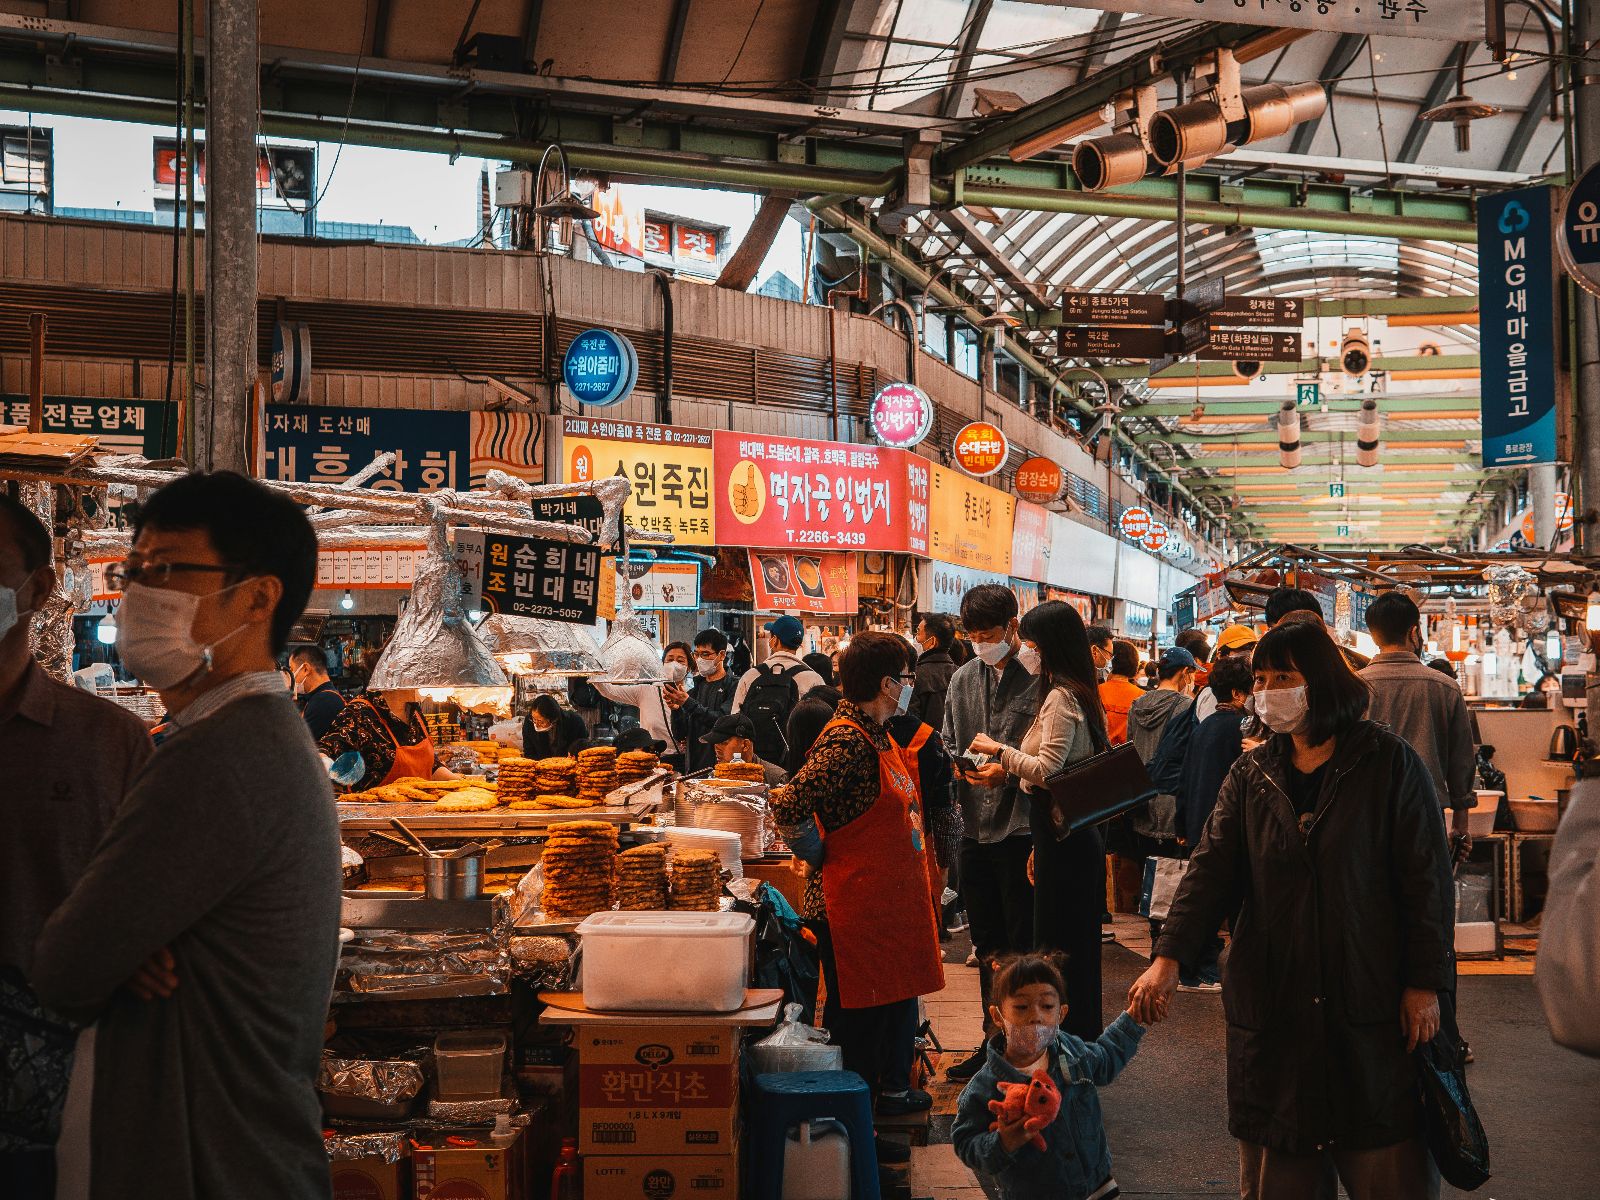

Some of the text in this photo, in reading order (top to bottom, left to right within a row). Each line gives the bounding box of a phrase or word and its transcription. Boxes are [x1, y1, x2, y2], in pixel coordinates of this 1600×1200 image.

[1249, 299, 1275, 310] 청계천
[568, 355, 619, 376] 수원아줌마
[575, 382, 610, 391] 2271-2627
[43, 404, 144, 430] 전문업체
[318, 416, 371, 435] 도산매
[565, 420, 589, 435] 2대째
[591, 423, 633, 439] 수원아줌마
[645, 427, 661, 441] 전문
[964, 456, 996, 467] 빈대떡
[1019, 471, 1059, 488] 광장순대
[540, 502, 577, 516] 박가네
[679, 517, 709, 535] 녹두죽
[786, 530, 866, 545] T.2266-3439
[514, 544, 597, 578] 순희네
[513, 572, 594, 606] 빈대떡
[513, 602, 583, 619] 02-2273-5057
[601, 1070, 709, 1103] 환만식초
